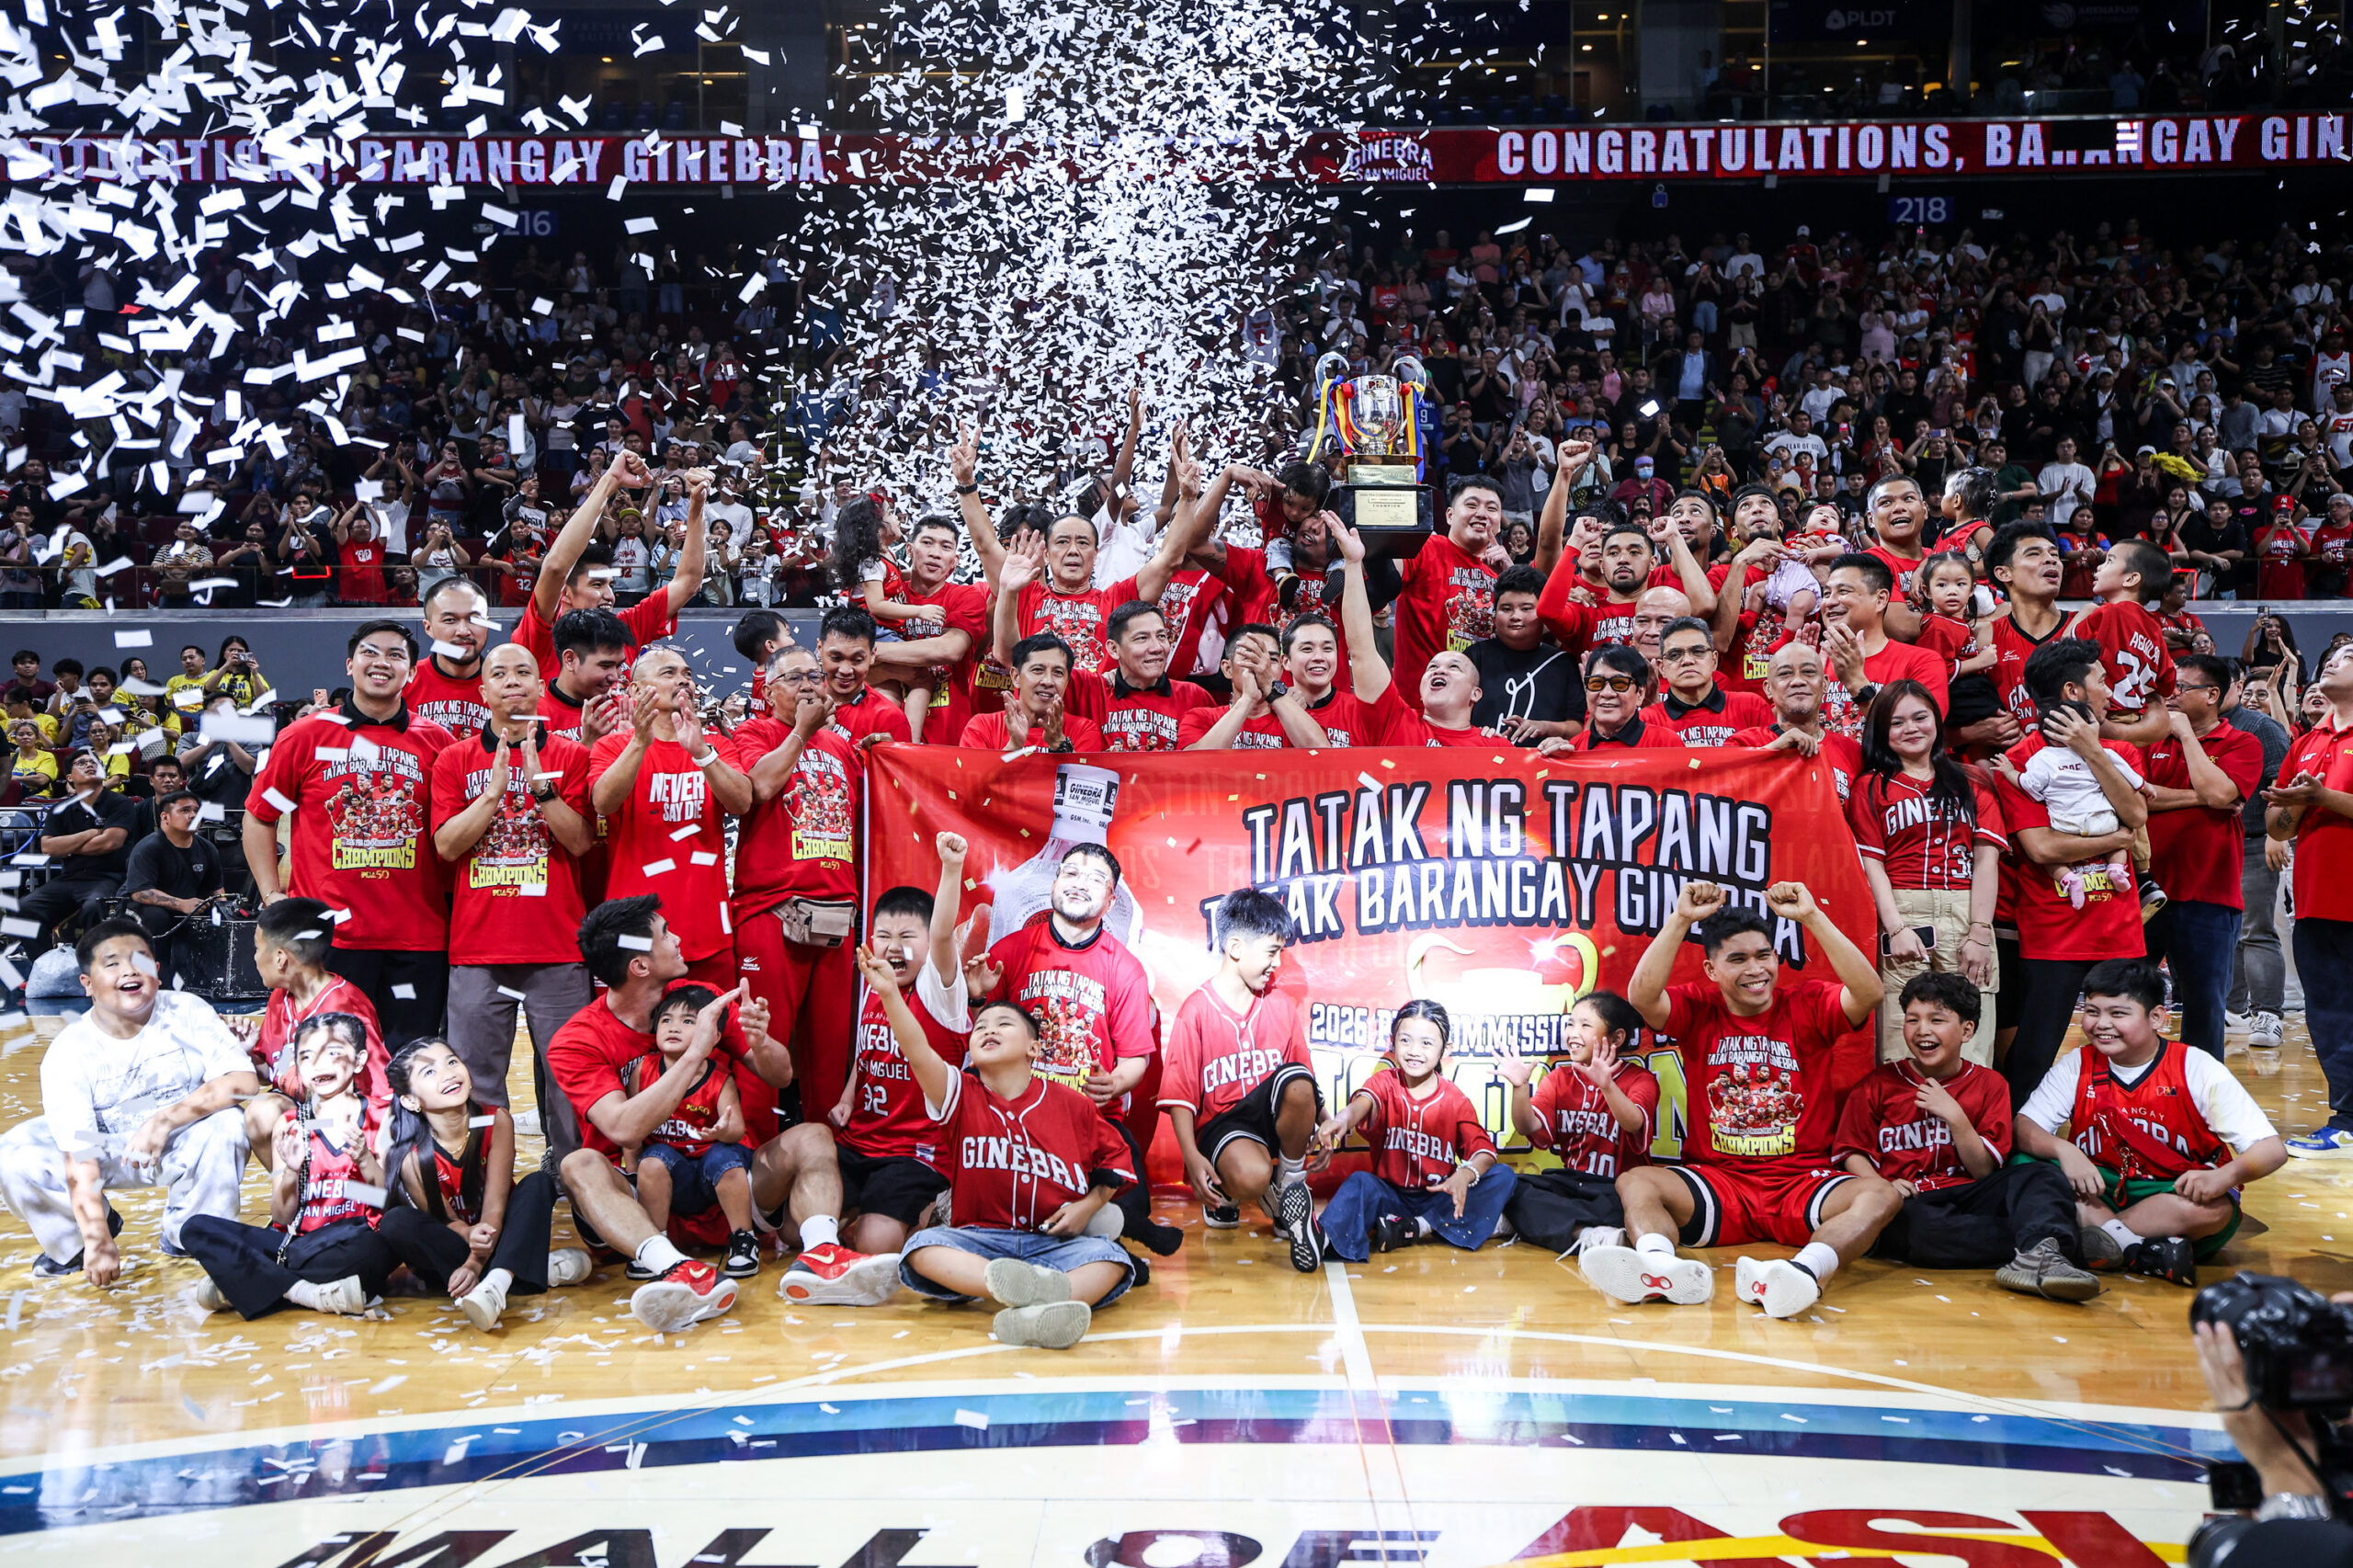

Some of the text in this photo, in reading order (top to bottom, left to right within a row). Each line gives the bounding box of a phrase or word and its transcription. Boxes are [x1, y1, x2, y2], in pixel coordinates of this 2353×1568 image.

[1847, 10, 1896, 27] PLDT
[1348, 139, 1434, 171] GINEBRA
[1497, 123, 1964, 175] CONGRATULATIONS,
[2261, 116, 2353, 161] GIN
[359, 139, 605, 182] BARANGAY
[623, 139, 825, 182] GINEBRA
[1385, 166, 1430, 181] MIGUEL
[1896, 197, 1947, 222] 218
[503, 210, 551, 235] 16
[516, 578, 531, 591] 32
[1619, 617, 1630, 628] NG
[417, 700, 494, 721] TATAK NG TAPAN
[1108, 709, 1134, 725] TATAK
[1135, 709, 1148, 722] NG
[833, 723, 852, 742] PANG
[1121, 722, 1158, 733] BARANGAY
[1327, 728, 1350, 744] PANG
[1688, 727, 1701, 740] NG
[1242, 731, 1256, 744] NG
[1257, 732, 1283, 749] TAPANG
[381, 745, 419, 769] TAPANG
[323, 763, 348, 782] TATAK
[394, 762, 424, 784] GINEBRA
[466, 767, 494, 787] TATA
[649, 770, 706, 803] NEVER
[1070, 783, 1103, 799] GINEBRA
[663, 800, 704, 822] SAY DIE
[1081, 795, 1100, 805] MIGUEL
[1245, 779, 1772, 887] TATAK NG TAPANG
[333, 837, 417, 870] CHAMPIONS
[792, 830, 853, 865] CHAMPIONS
[469, 857, 549, 890] CHAMPIONS
[1355, 856, 1606, 937] BARANGAY
[1020, 985, 1042, 1002] TATAK
[1029, 969, 1106, 1000] TATAK NG TAPANG
[1311, 1002, 1369, 1047] 2026
[1743, 1037, 1756, 1051] NG
[1728, 1051, 1768, 1064] BARANGAY
[863, 1083, 890, 1117] 32
[1709, 1122, 1796, 1157] CHAMPIONS
[1878, 1116, 1954, 1154] GINEB
[962, 1135, 1089, 1195] GINEBRA
[304, 1205, 321, 1219] AN
[1082, 1528, 1442, 1568] OF
[1507, 1506, 2174, 1568] ASI
